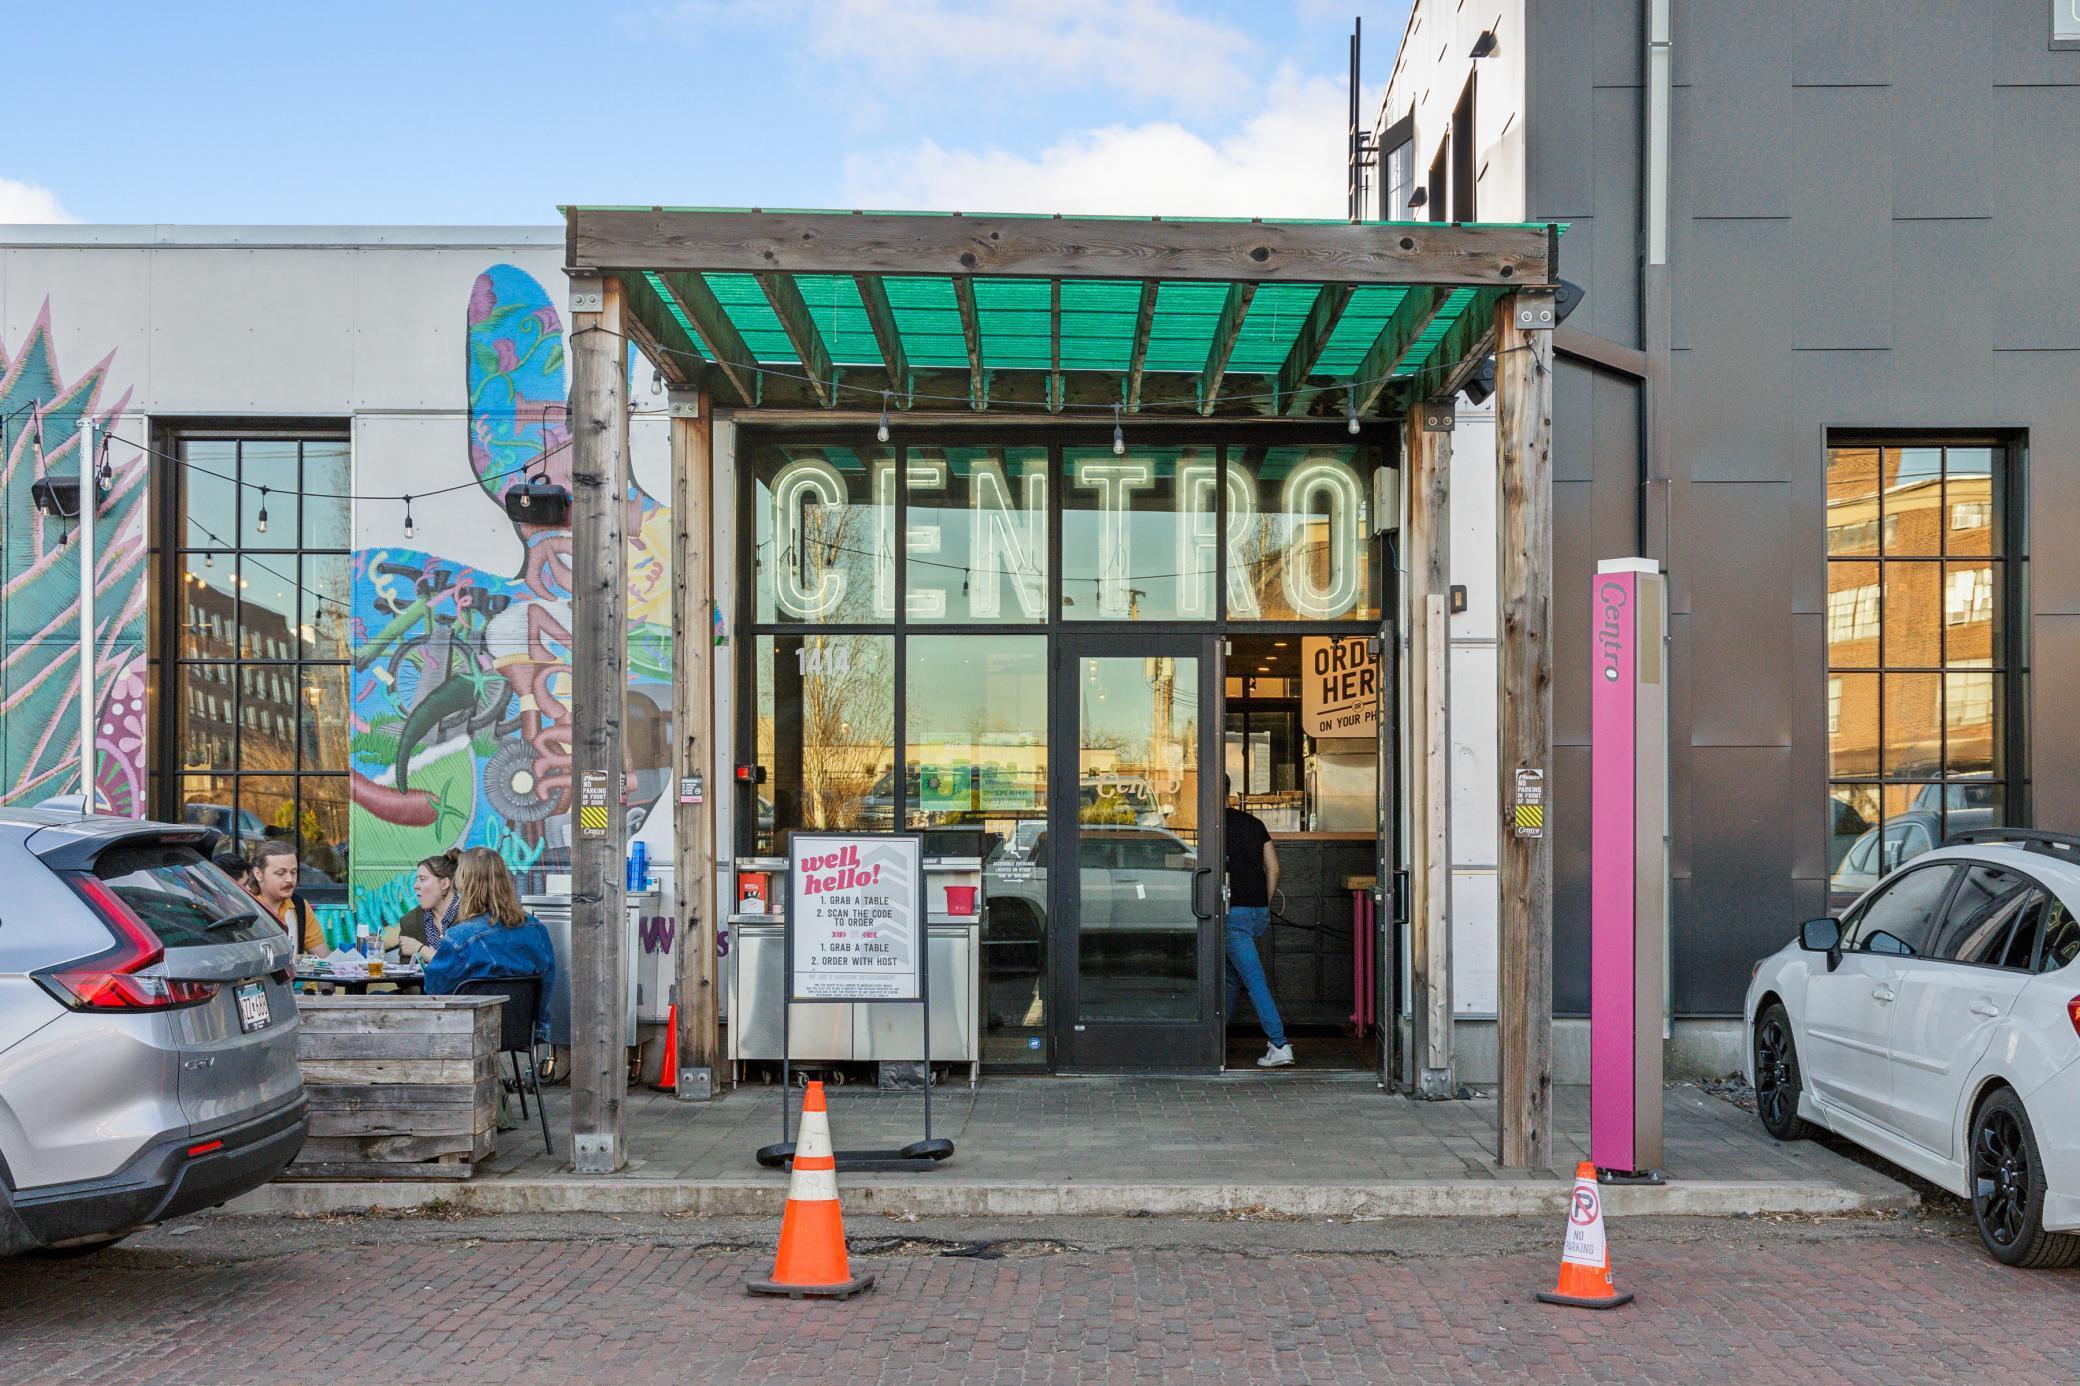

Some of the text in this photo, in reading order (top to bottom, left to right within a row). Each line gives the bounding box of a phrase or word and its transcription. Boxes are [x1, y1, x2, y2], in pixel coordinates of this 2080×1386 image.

[770, 457, 1365, 621] CENTRO
[1599, 582, 1627, 682] Centro
[795, 647, 851, 676] 1414
[1319, 720, 1332, 732] ON
[1336, 713, 1361, 729] YOUR
[1517, 779, 1527, 787] NO
[801, 845, 861, 873] well,
[803, 864, 881, 895] hello!
[820, 896, 889, 905] 1. GRAB A TABLE
[816, 908, 892, 918] 2. SCAN THE CODE
[834, 918, 874, 927] TO ORDER
[820, 943, 889, 952] 1. GRAB A TABLE
[811, 956, 897, 966] 2. ORDER WITH HOST
[1573, 1229, 1584, 1241] NO
[1565, 1240, 1595, 1255] PARKING
